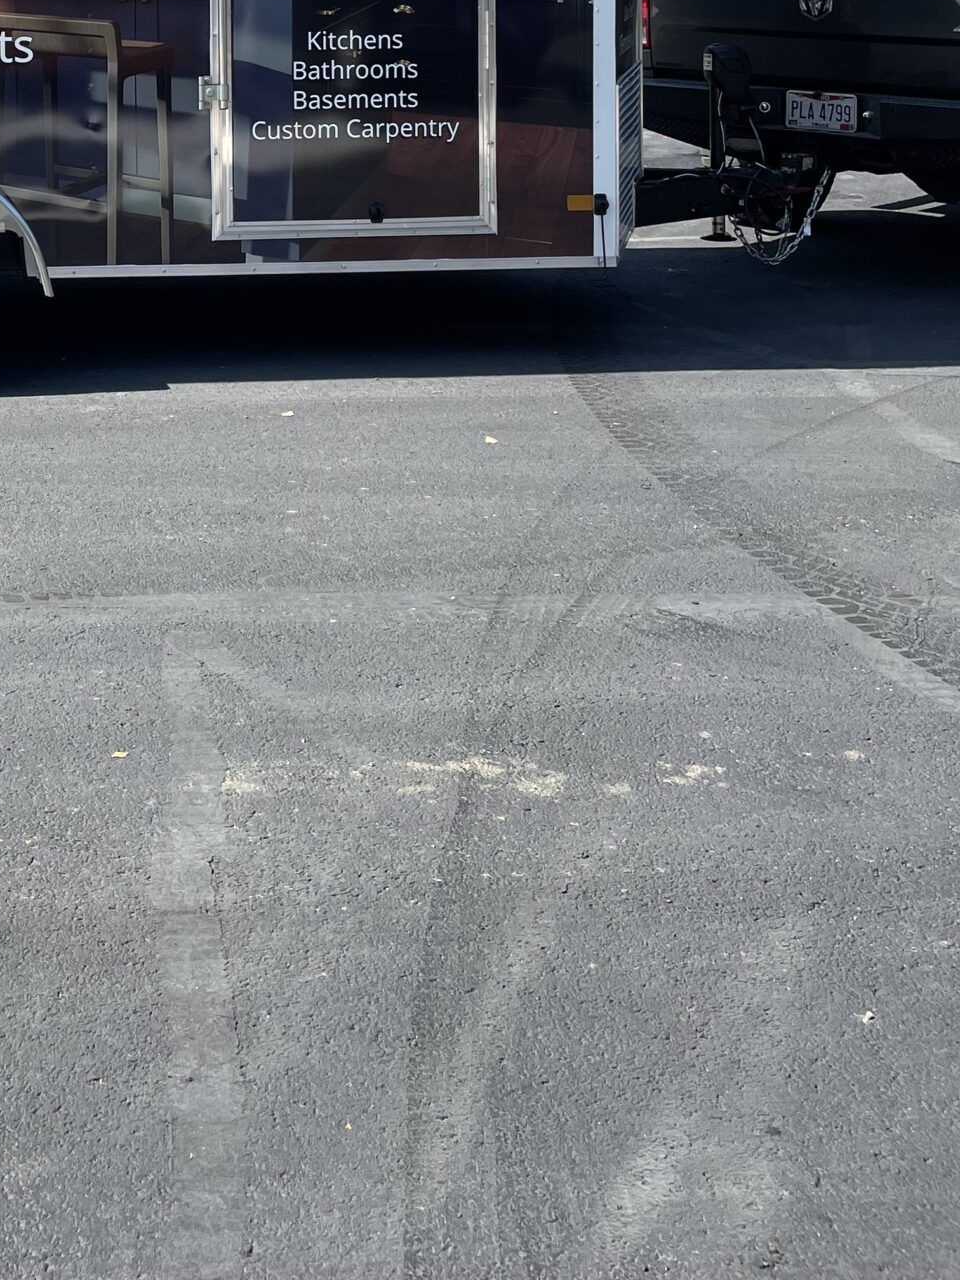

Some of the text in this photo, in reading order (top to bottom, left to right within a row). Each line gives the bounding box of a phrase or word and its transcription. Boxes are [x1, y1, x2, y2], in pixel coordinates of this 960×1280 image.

[307, 30, 403, 51] Kitchens
[292, 60, 418, 80] Bathrooms
[293, 90, 418, 110] Basements
[791, 100, 851, 123] PLA 4799
[251, 118, 460, 143] Custom Carpentry
